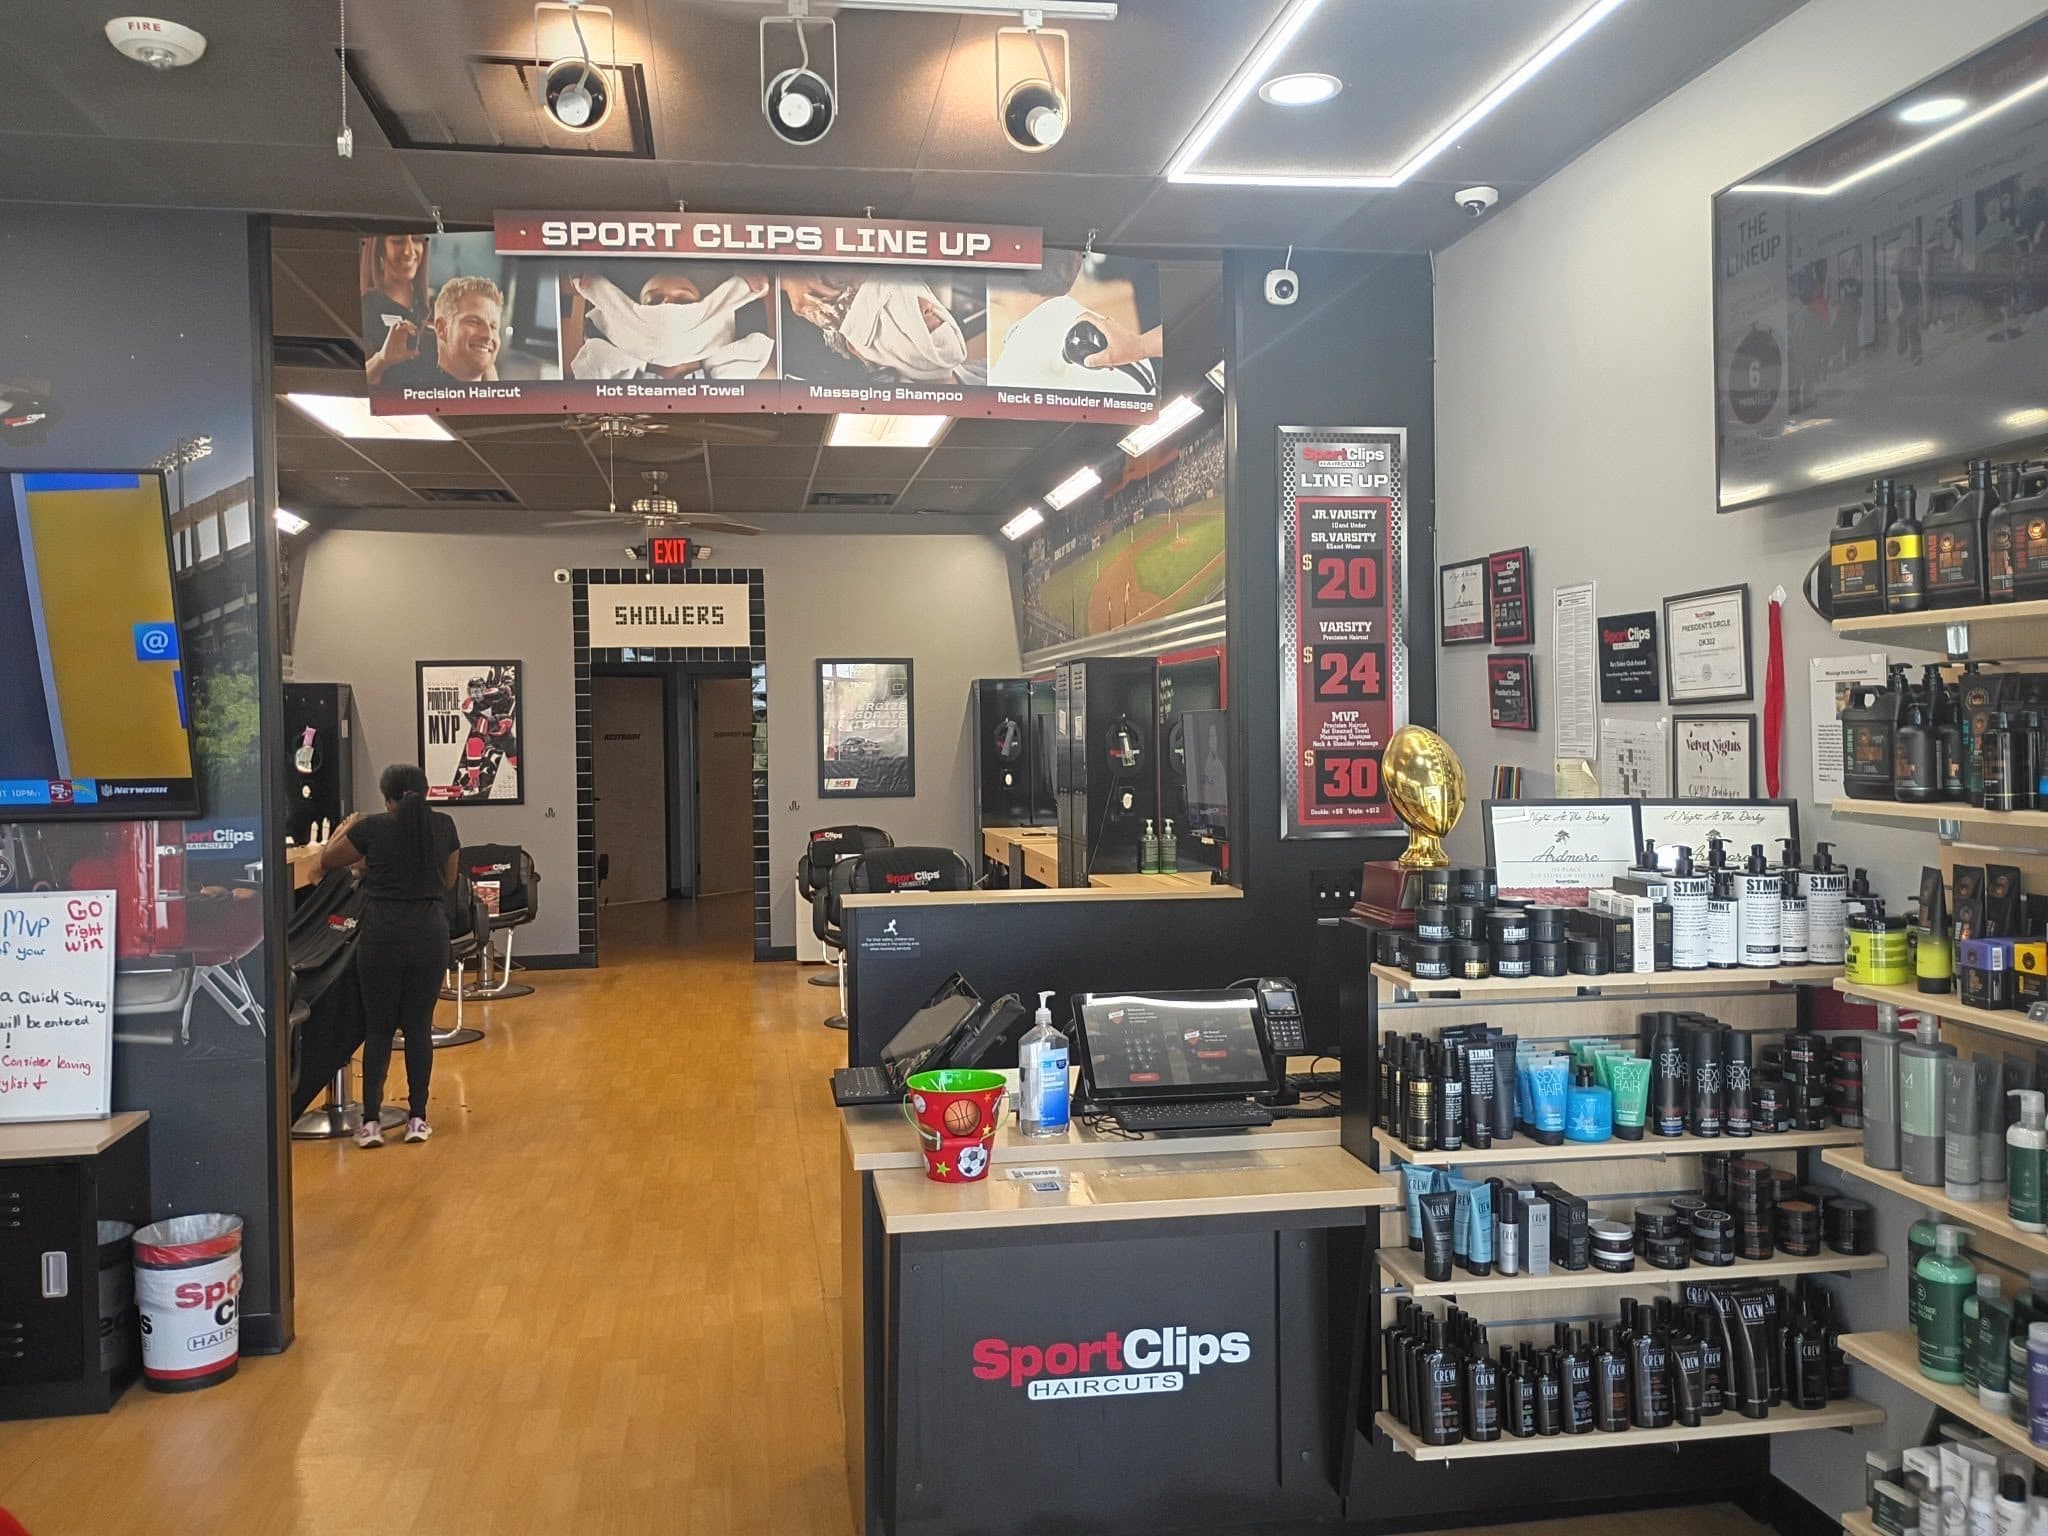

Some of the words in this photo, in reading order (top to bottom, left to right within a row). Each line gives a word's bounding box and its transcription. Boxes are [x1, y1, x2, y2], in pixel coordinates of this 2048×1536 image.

[128, 21, 161, 32] FIRE
[1738, 211, 1768, 240] THE
[541, 221, 682, 248] SPORT
[692, 223, 823, 251] CLIPS
[835, 227, 928, 255] LINE
[939, 231, 991, 257] UP
[404, 387, 466, 400] Precision
[469, 386, 521, 399] Haircut
[596, 385, 623, 397] Hot
[627, 384, 697, 397] Steamed
[700, 384, 745, 397] Towel
[809, 386, 891, 401] Massaging
[895, 388, 963, 402] Shampoo
[998, 391, 1030, 405] Neck
[1034, 394, 1043, 405] &
[1046, 394, 1099, 408] Shoulder
[1103, 398, 1154, 412] Massage
[1301, 473, 1352, 488] LINE
[1358, 474, 1389, 489] UP
[654, 540, 687, 564] EXIT
[615, 606, 725, 625] SHOWERS
[1319, 621, 1373, 633] VARSITY
[857, 702, 907, 711] ERGIZE
[854, 711, 906, 720] GORATE
[1331, 711, 1359, 722] MVP
[428, 715, 460, 744] MVP
[1686, 739, 1713, 762] Velvet
[1712, 739, 1742, 756] Nights
[188, 827, 255, 844] ortClips
[1532, 845, 1600, 863] Ardmore
[67, 899, 103, 921] GO
[1707, 902, 1731, 911] TMNT
[4, 909, 50, 938] MVP
[65, 921, 104, 938] Fight
[16, 944, 46, 961] your
[18, 988, 59, 1004] Quick
[63, 991, 106, 1013] Survey
[26, 1014, 42, 1028] be
[44, 1015, 90, 1028] entered
[1468, 1049, 1494, 1060] STMNT
[2, 1054, 51, 1068] Consider
[57, 1055, 91, 1076] leaving
[1726, 1065, 1750, 1078] SEXY
[1536, 1070, 1564, 1084] SEXY
[1614, 1066, 1642, 1079] SEXY
[0, 1075, 28, 1093] ylist
[1537, 1083, 1564, 1096] HAIR
[1613, 1079, 1641, 1093] HAIR
[1698, 1082, 1720, 1094] HAIR
[1727, 1078, 1750, 1090] HAIR
[1408, 1178, 1428, 1190] CREW
[1457, 1193, 1471, 1206] REW
[1431, 1205, 1450, 1217] CREW
[175, 1273, 241, 1310] Spo
[1720, 1297, 1731, 1313] CR
[1742, 1303, 1764, 1320] CREW
[192, 1327, 238, 1349] HAIR
[972, 1326, 1251, 1387] SportClips
[1704, 1351, 1721, 1364] CREW
[1802, 1345, 1821, 1357] CREW
[1643, 1353, 1665, 1366] CREW
[1682, 1357, 1699, 1369] CREW
[1572, 1366, 1590, 1378] CREW
[1607, 1363, 1625, 1375] CREW
[1434, 1370, 1456, 1383] CREW
[1475, 1374, 1496, 1385] CREW
[1033, 1375, 1178, 1397] HAIRCUTS
[1542, 1385, 1559, 1396] CREW
